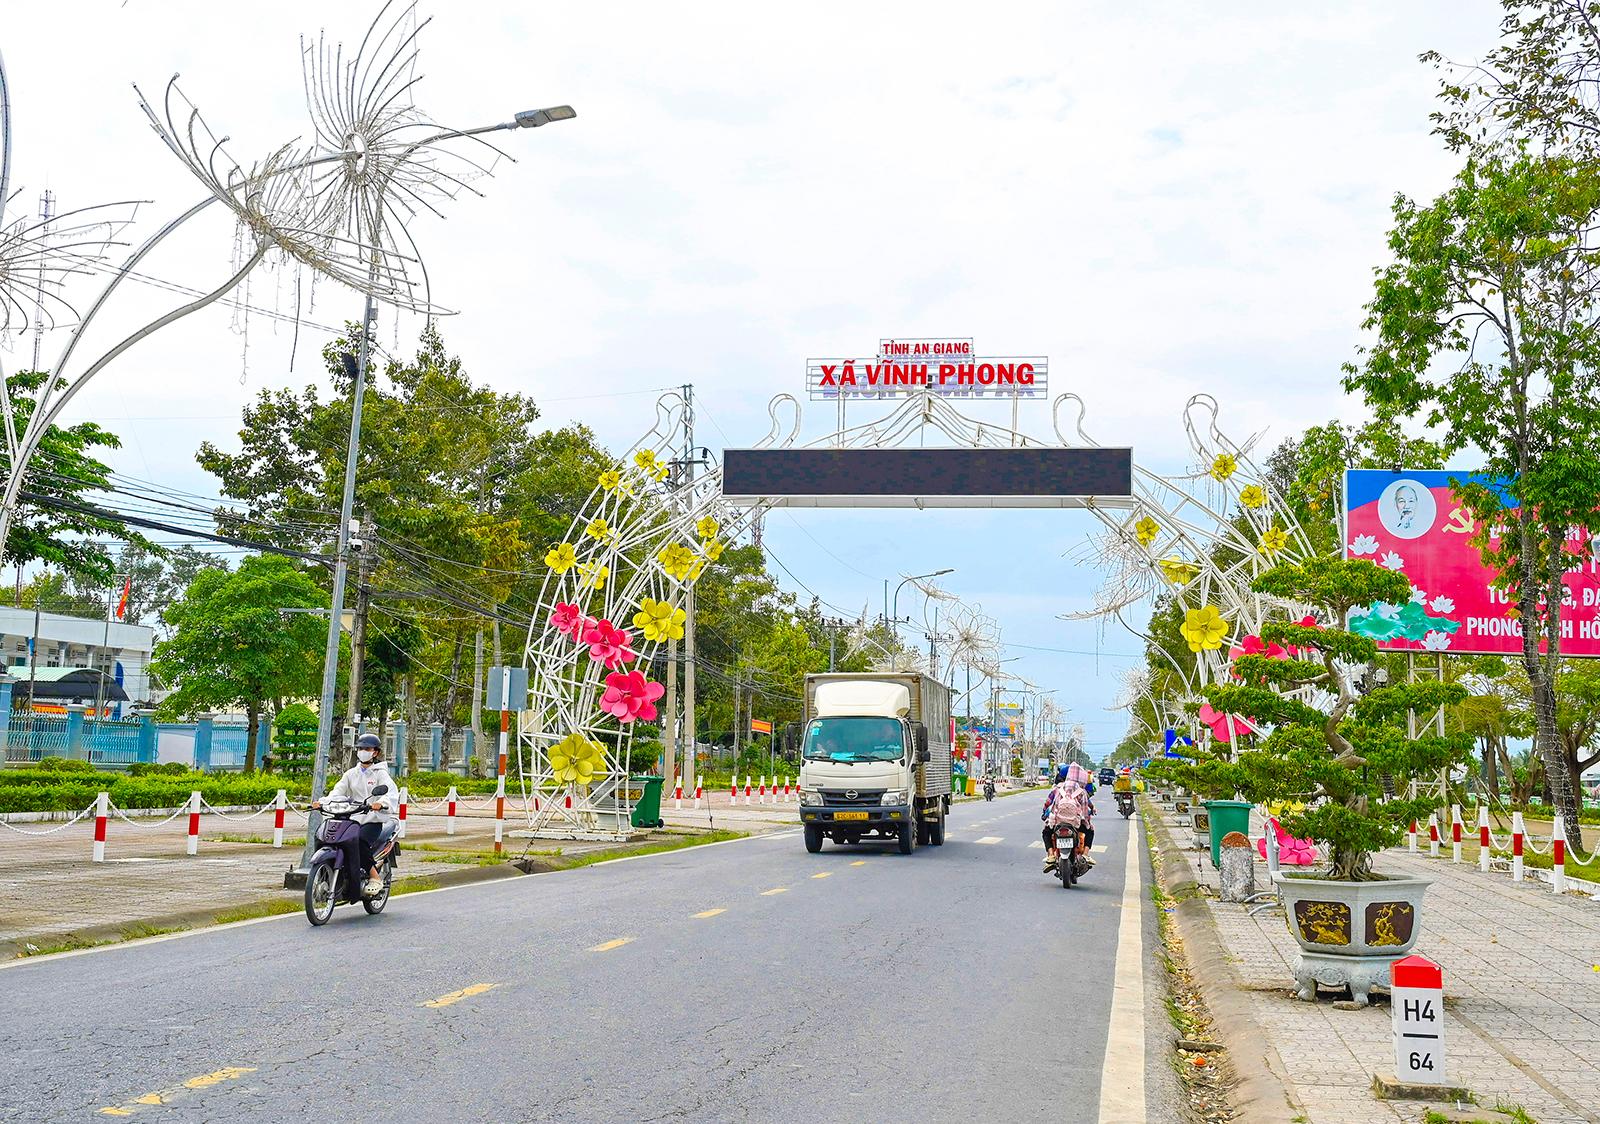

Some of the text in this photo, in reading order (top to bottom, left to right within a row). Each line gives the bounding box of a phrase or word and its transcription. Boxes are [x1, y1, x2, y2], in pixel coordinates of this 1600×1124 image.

[883, 340, 970, 354] TỈNH AN GIANG
[819, 359, 1035, 385] XÃ VĨNH PHONG
[1467, 617, 1523, 637] PHONG
[1403, 999, 1435, 1022] H4
[1409, 1052, 1434, 1071] 64
